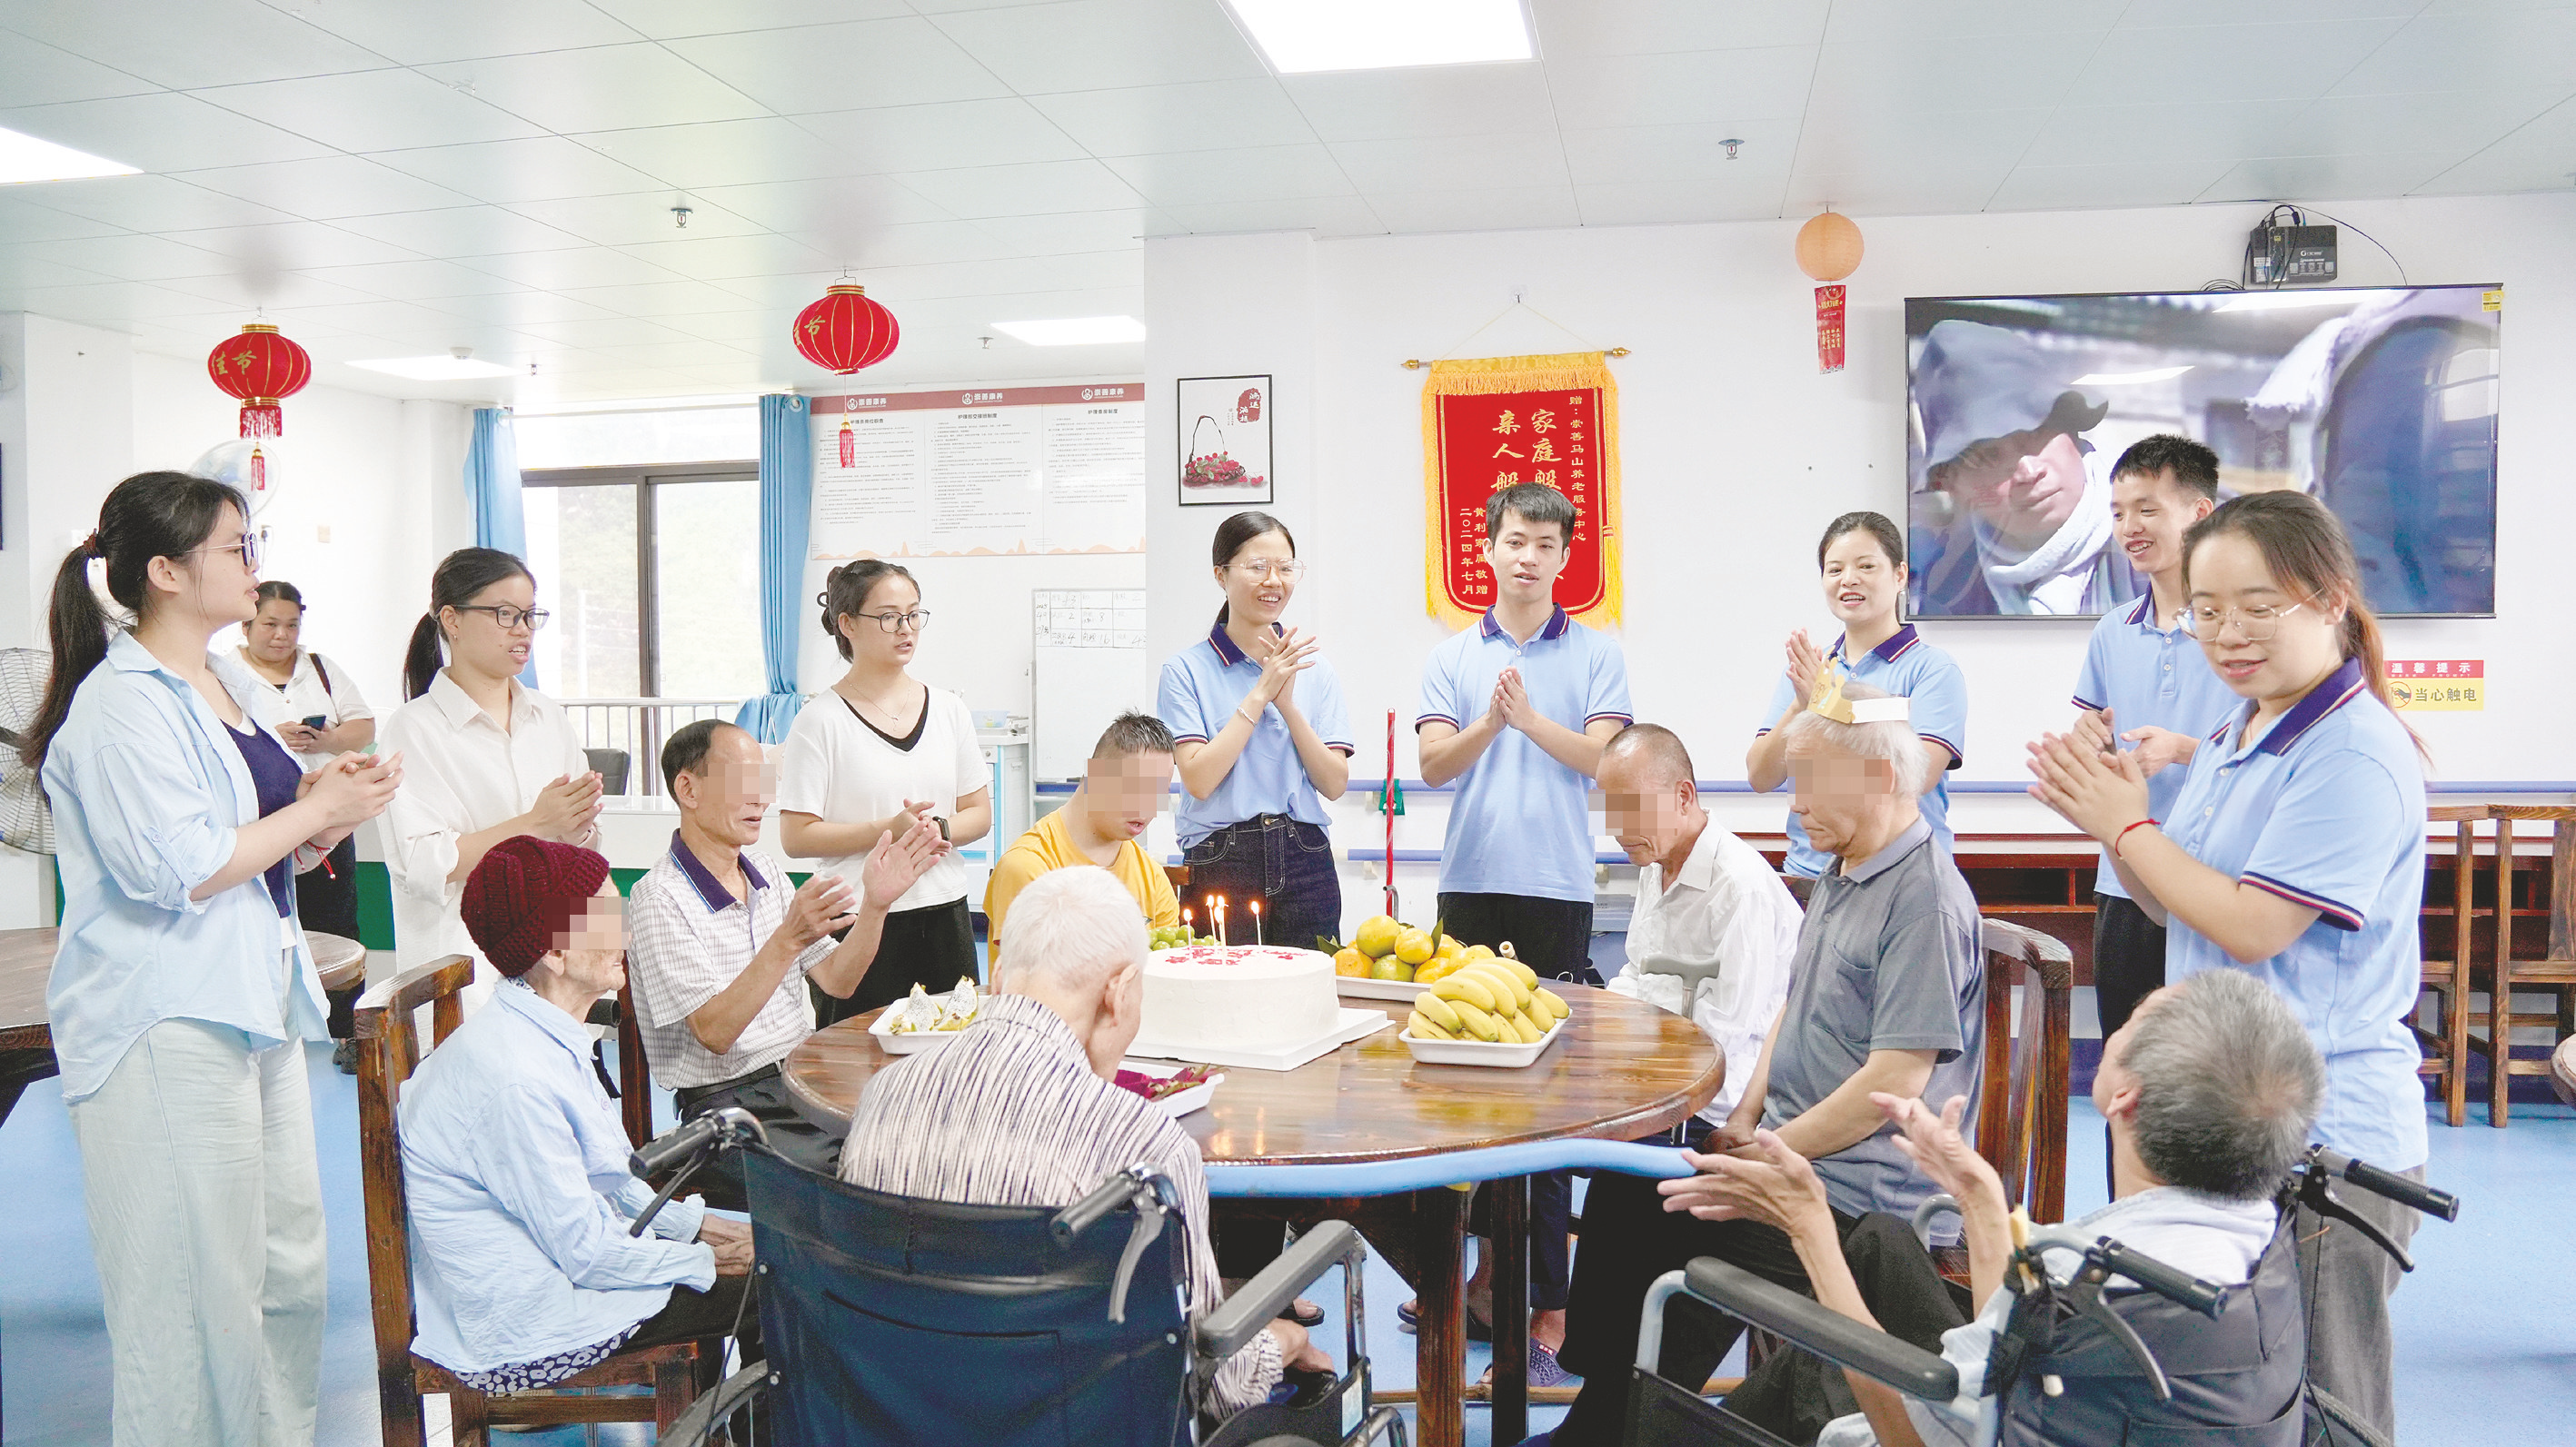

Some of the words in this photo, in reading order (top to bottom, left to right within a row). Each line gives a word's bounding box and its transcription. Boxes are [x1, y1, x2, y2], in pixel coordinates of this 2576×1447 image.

[2391, 662, 2471, 674] 温馨提示
[2415, 688, 2477, 702] 当心触电
